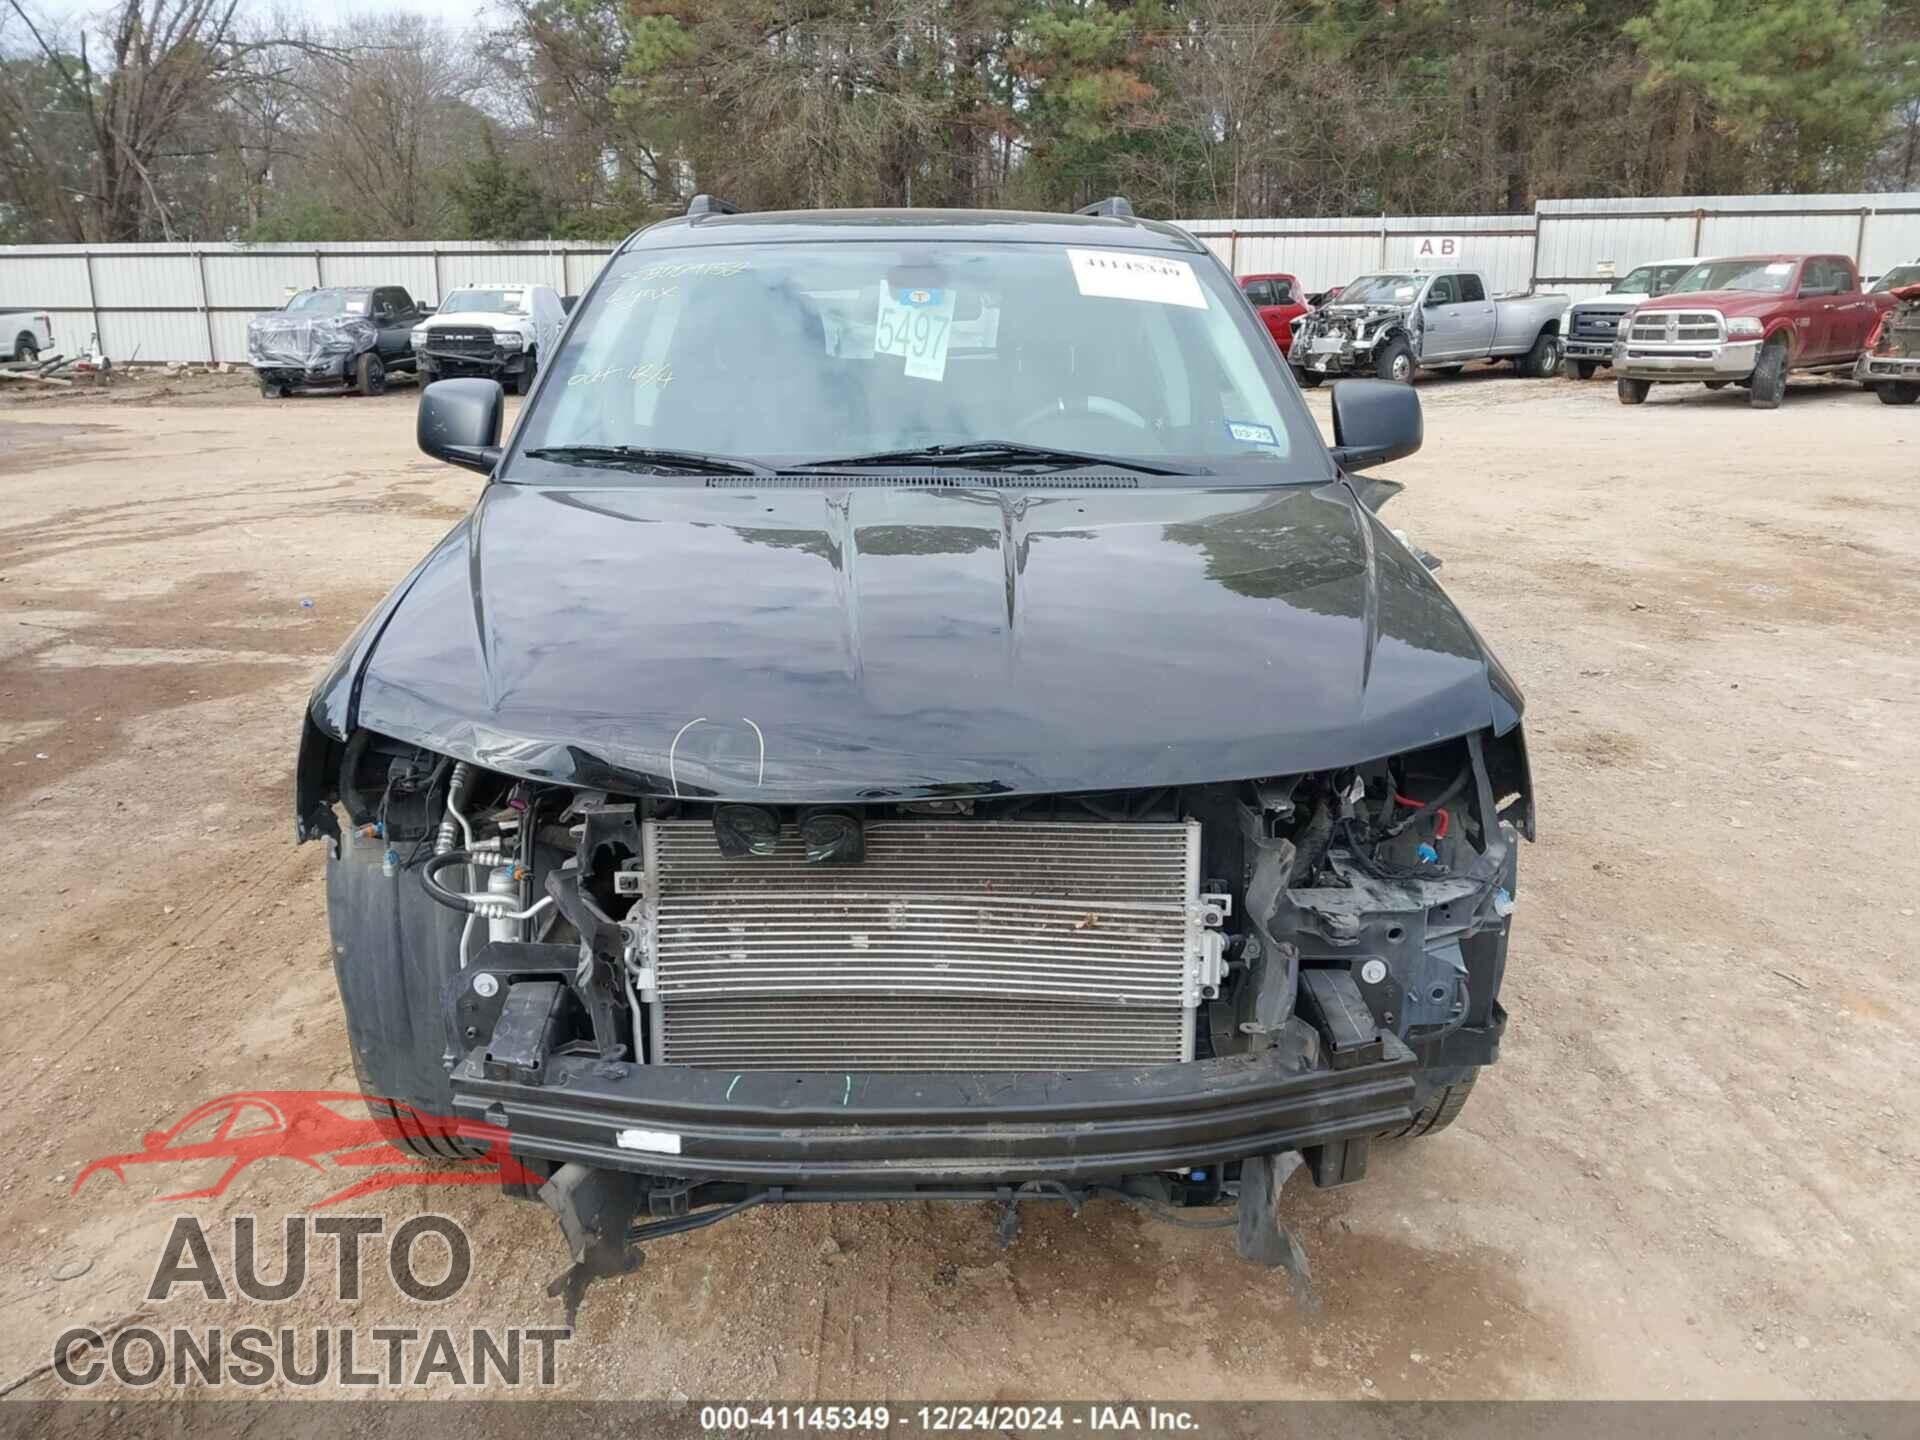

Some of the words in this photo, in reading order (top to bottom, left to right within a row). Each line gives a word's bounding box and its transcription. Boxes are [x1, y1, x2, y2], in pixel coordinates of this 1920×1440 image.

[1420, 239, 1433, 255] A
[1441, 239, 1455, 255] B
[878, 307, 951, 360] 5497
